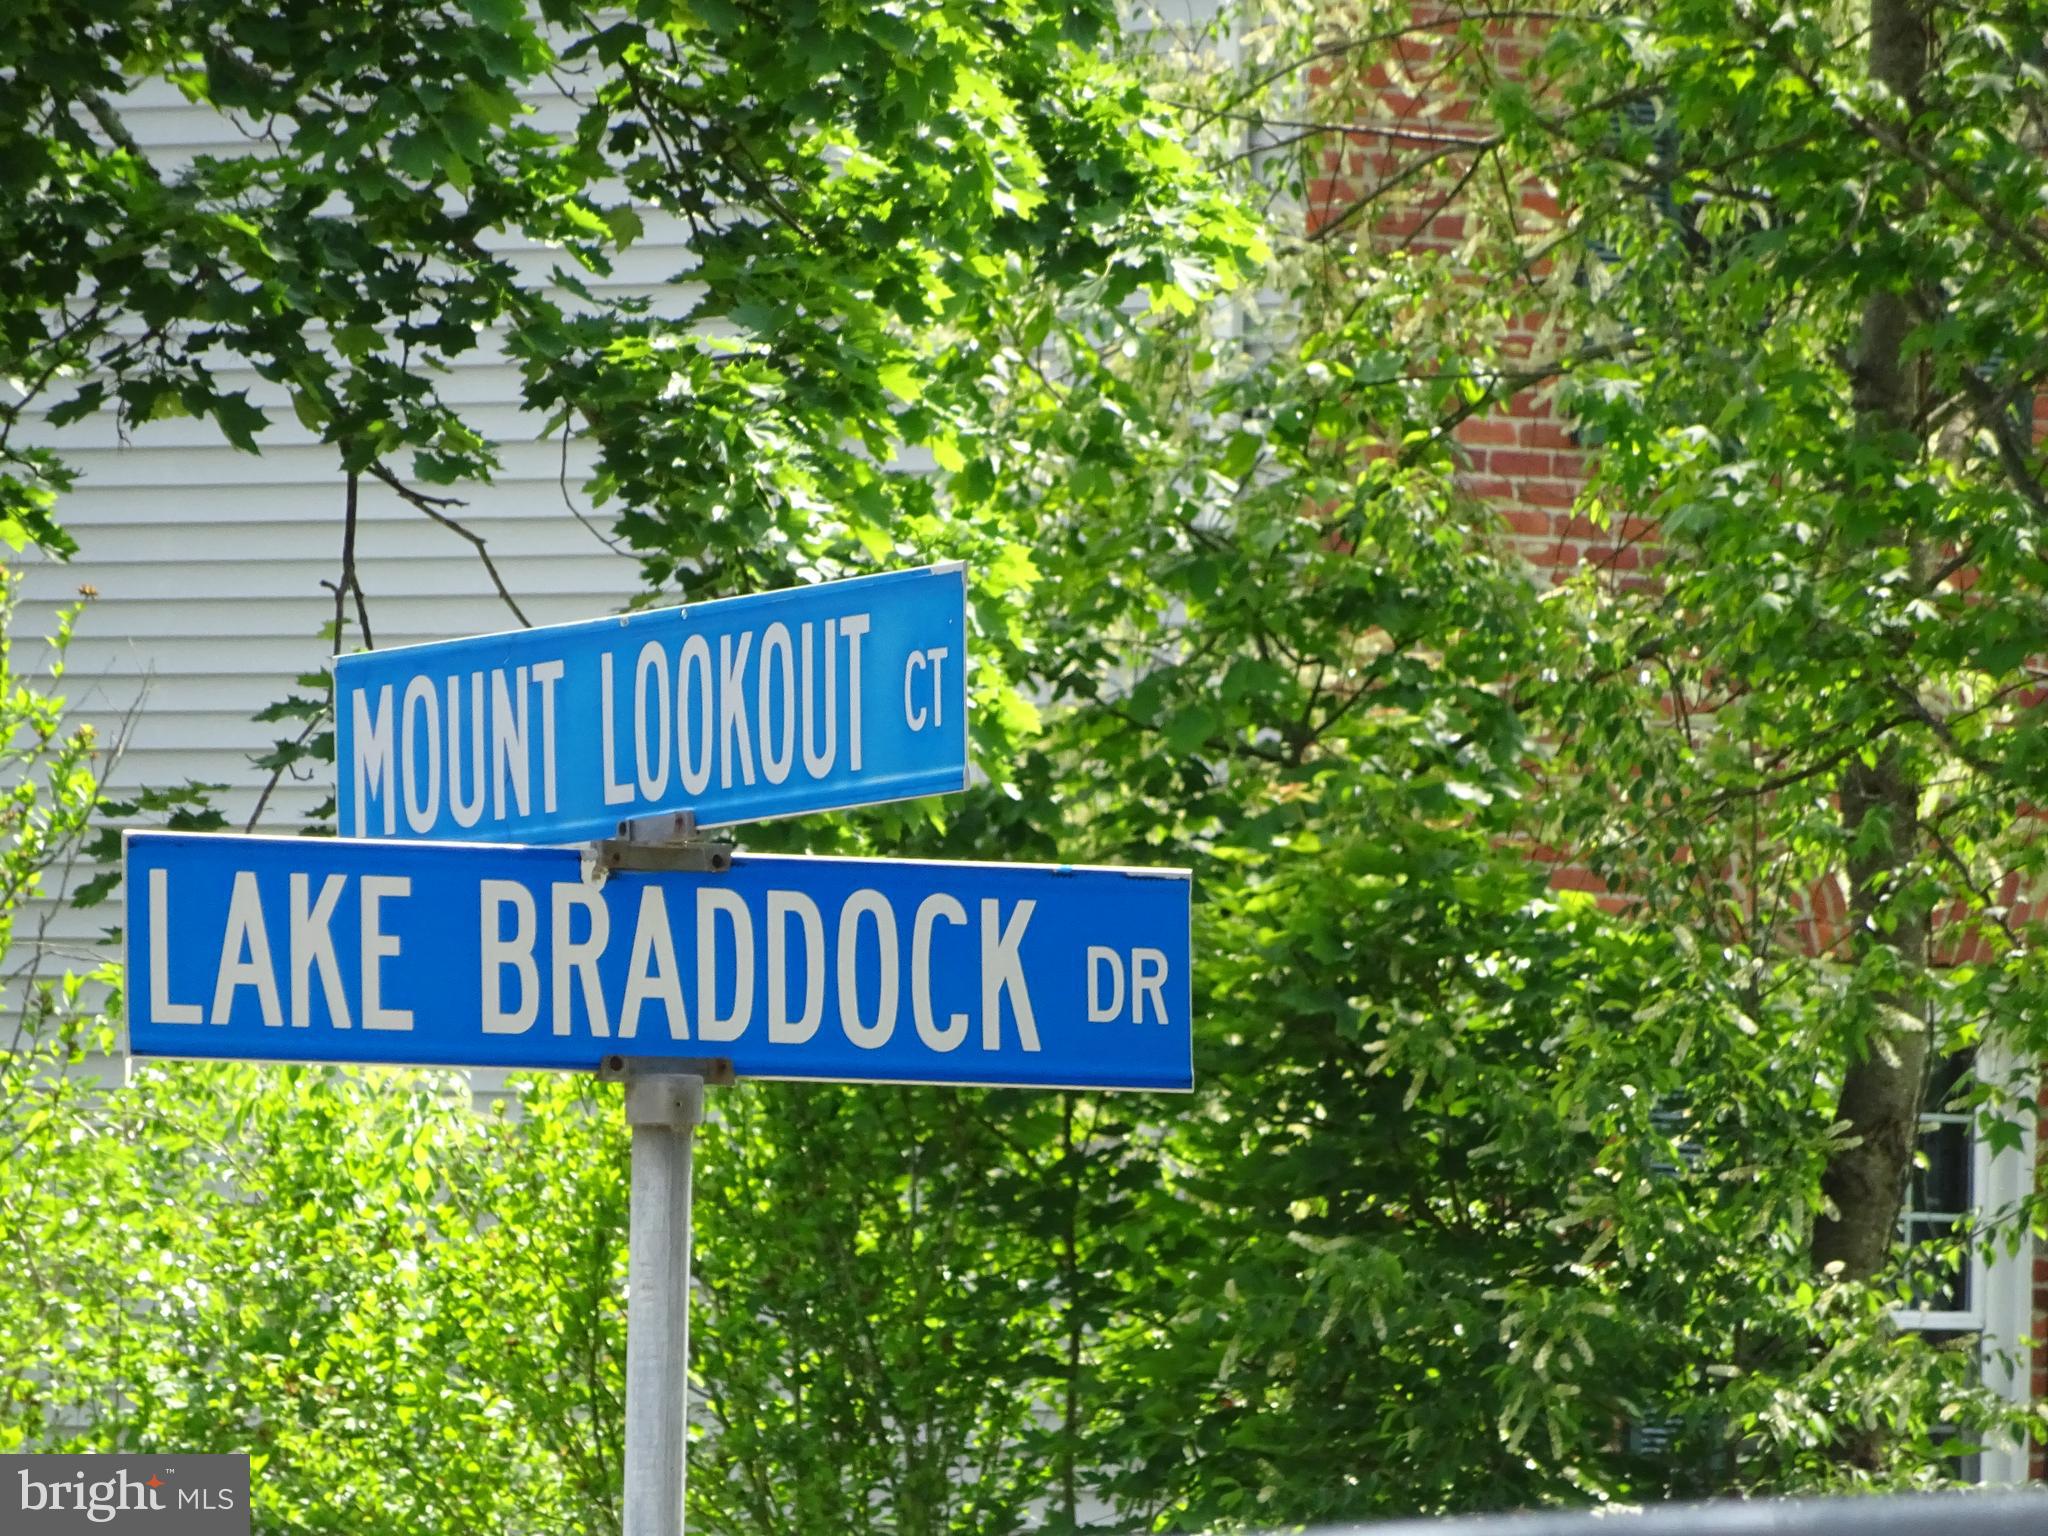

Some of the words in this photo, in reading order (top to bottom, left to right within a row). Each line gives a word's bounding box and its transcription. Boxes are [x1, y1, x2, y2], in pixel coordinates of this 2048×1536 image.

[352, 658, 565, 838] MOUNT
[600, 613, 870, 806] LOOKOUT
[904, 646, 949, 733] CT
[147, 867, 415, 1032] LAKE
[480, 878, 1042, 1053] BRADDOCK
[1086, 945, 1169, 1027] DR
